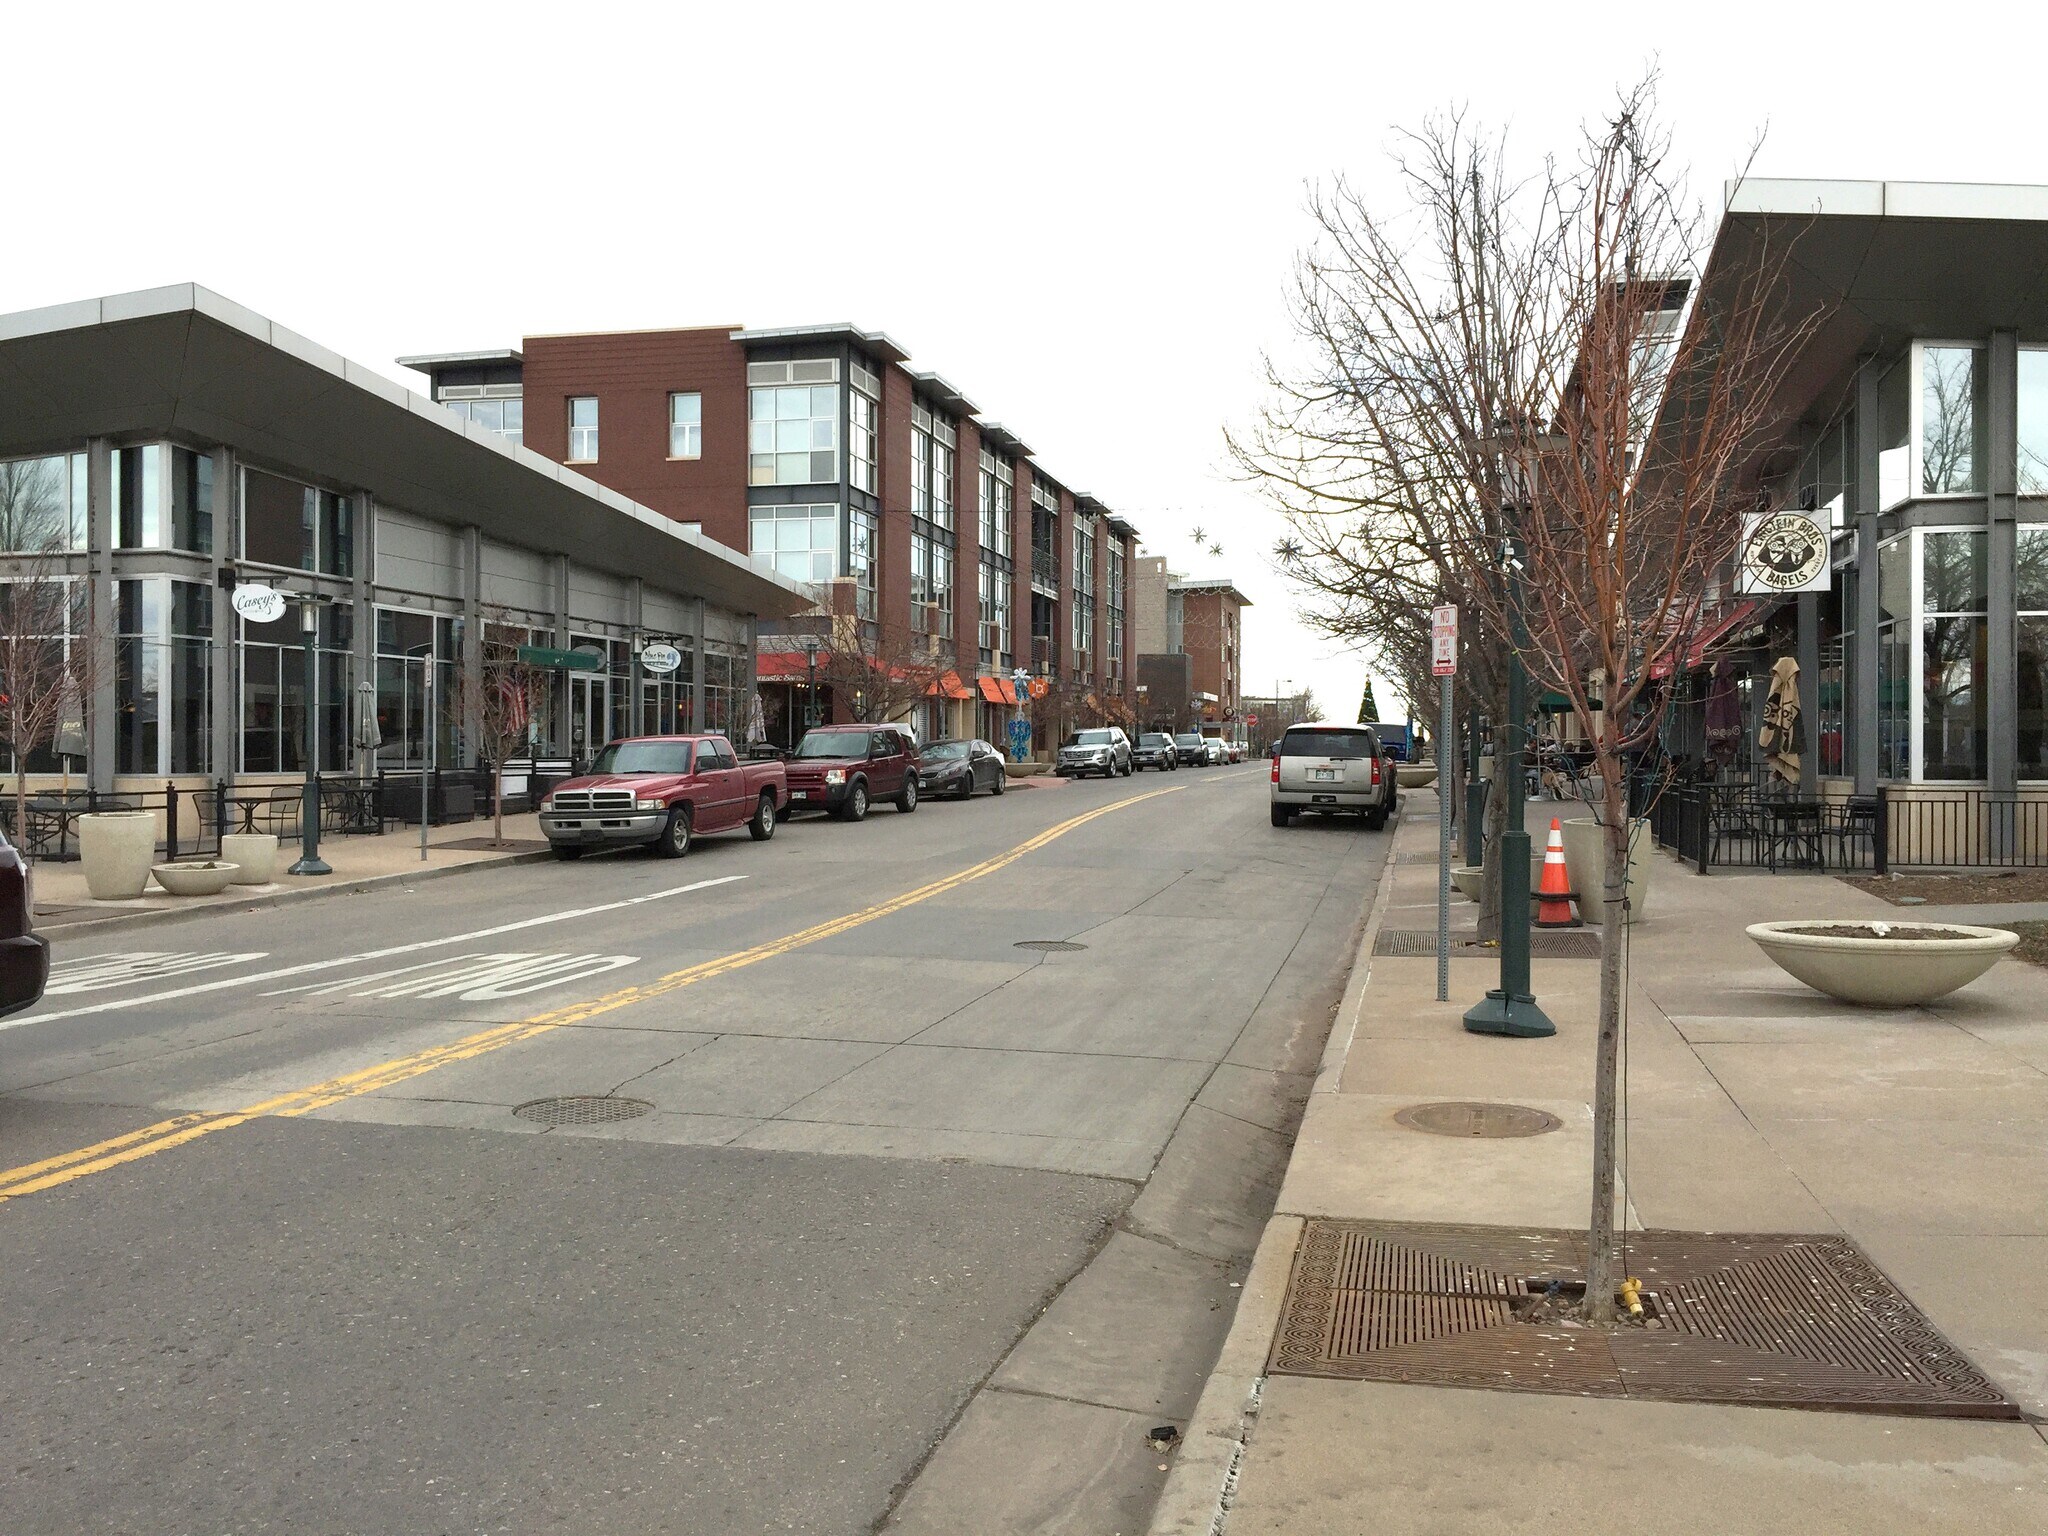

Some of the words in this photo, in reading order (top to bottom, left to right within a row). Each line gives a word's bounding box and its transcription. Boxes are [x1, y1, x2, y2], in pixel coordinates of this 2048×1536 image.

[1798, 521, 1822, 546] BROS
[1766, 570, 1808, 586] BAGELS
[237, 592, 277, 615] Casey's
[1440, 611, 1450, 623] NO
[1433, 625, 1456, 638] STOPPING
[1440, 639, 1449, 647] ANY
[1439, 648, 1450, 657] TIME
[256, 953, 641, 1001] ONLY
